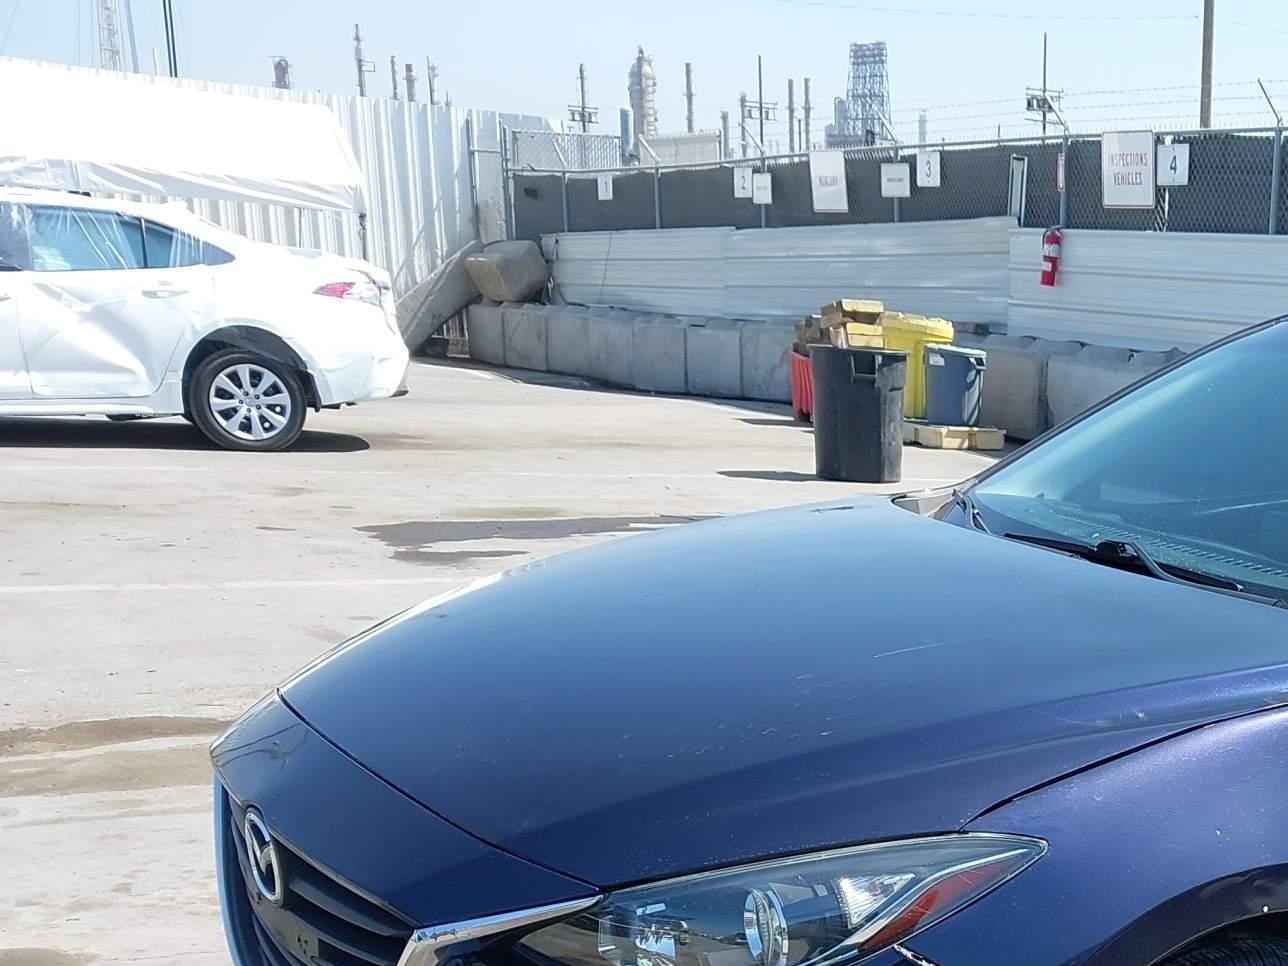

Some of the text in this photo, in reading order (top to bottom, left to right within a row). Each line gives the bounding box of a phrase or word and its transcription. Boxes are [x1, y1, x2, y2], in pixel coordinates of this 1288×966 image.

[1107, 152, 1149, 168] INSPECTIONS
[1169, 155, 1178, 174] 4
[925, 159, 932, 178] 3
[740, 175, 746, 190] 2
[1113, 171, 1143, 186] VEHICLES
